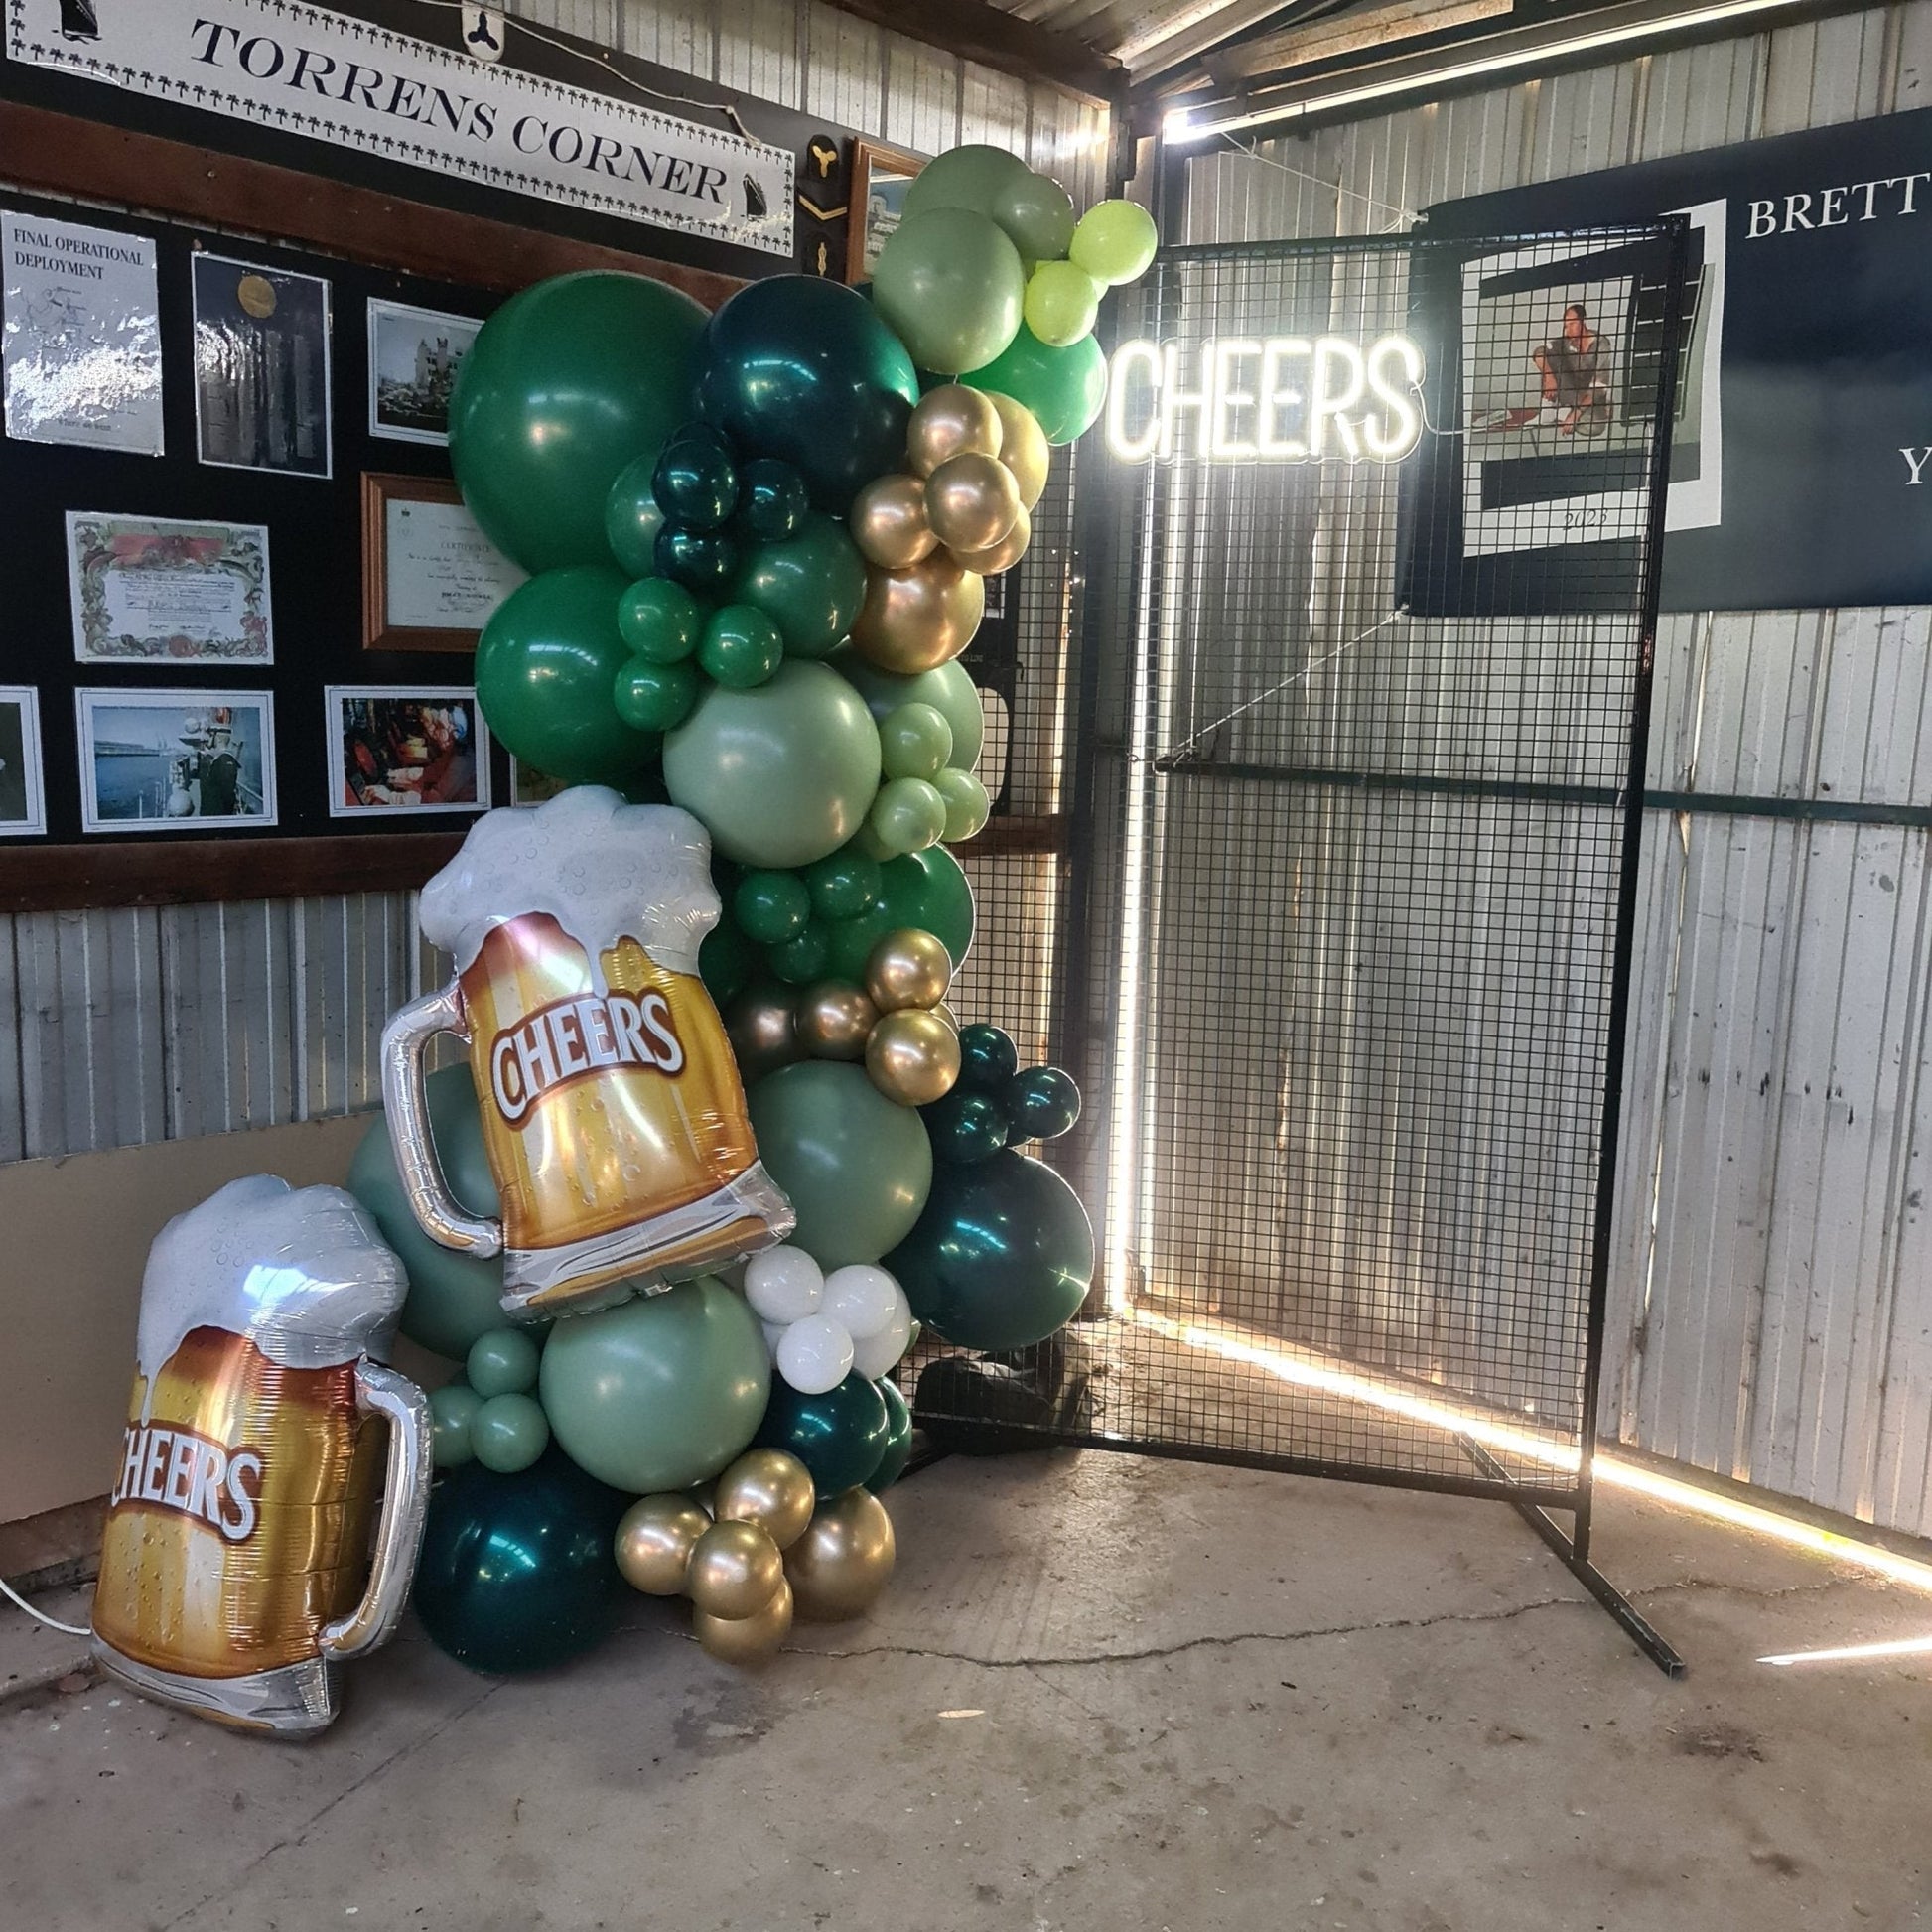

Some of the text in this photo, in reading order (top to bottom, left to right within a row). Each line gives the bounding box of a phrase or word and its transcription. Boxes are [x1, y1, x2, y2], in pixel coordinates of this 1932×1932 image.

[192, 18, 730, 204] TORRENS CORNER
[14, 228, 144, 266] FINAL OPERATIONAL
[1744, 172, 1931, 239] BRETT
[15, 252, 104, 280] DEPLOYMENT
[1107, 338, 1426, 464] CHEERS
[492, 994, 683, 1120] CHEERS
